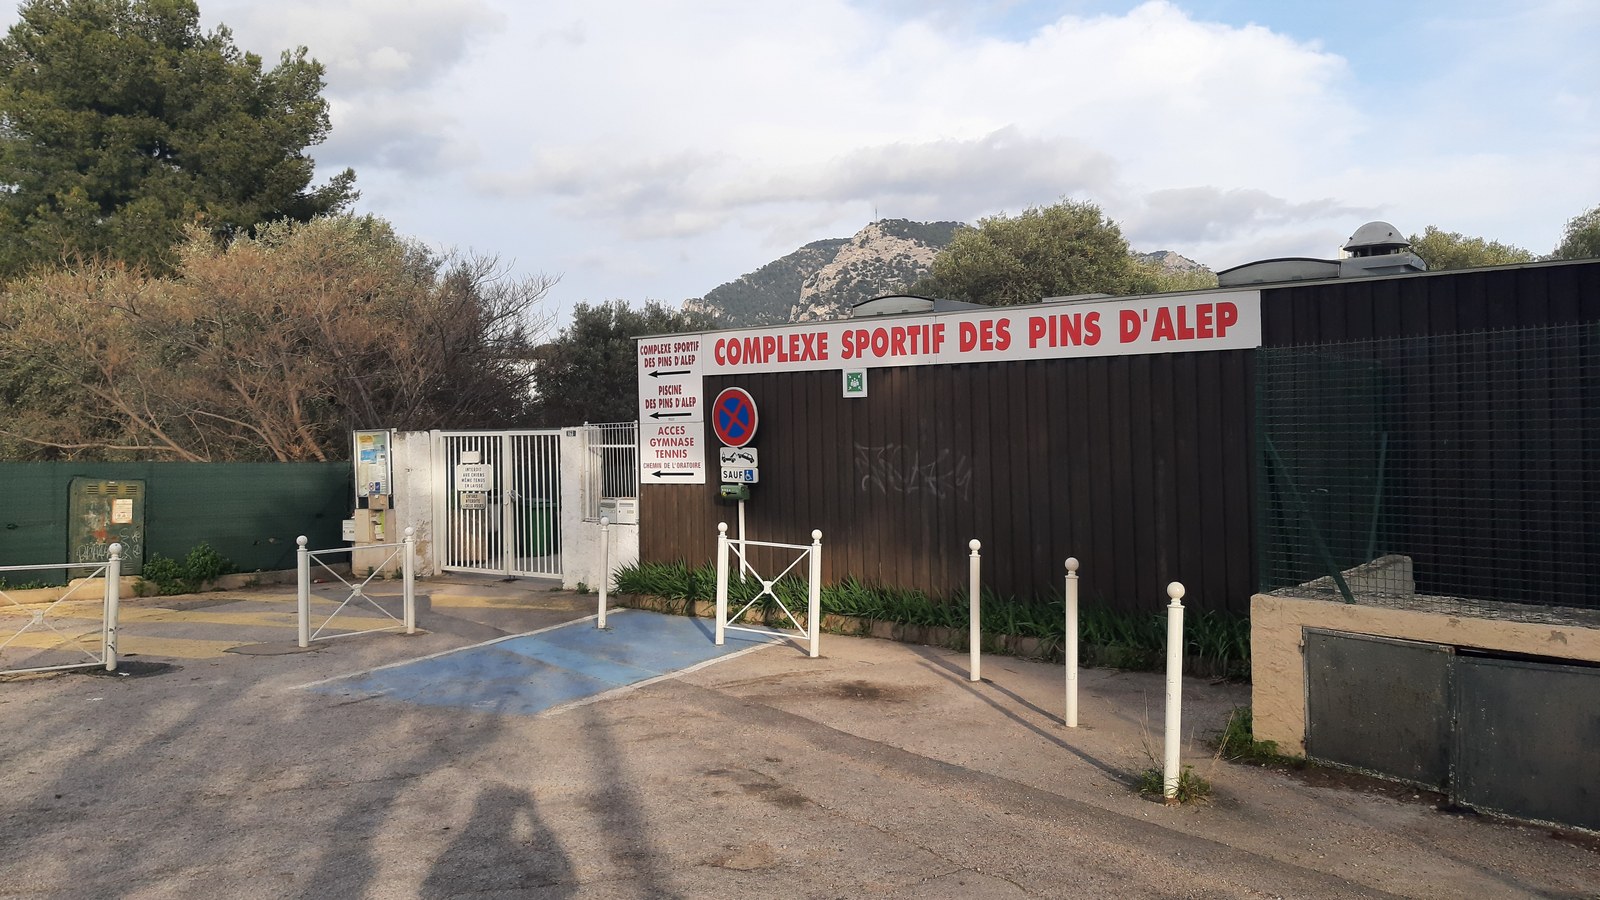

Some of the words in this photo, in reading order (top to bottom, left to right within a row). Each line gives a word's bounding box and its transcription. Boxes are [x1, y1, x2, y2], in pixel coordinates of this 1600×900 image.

[714, 332, 828, 366] COMPLEXE
[841, 323, 945, 360] SPORTIF
[959, 317, 1011, 353] DES
[1029, 311, 1101, 348] PINS
[1119, 301, 1239, 343] D'ALEP
[639, 343, 671, 356] COMPLEXE
[674, 340, 699, 353] SPORTIF
[644, 357, 655, 368] DES
[657, 356, 672, 367] PINS
[675, 354, 696, 366] D'ALEP
[658, 384, 682, 396] PISCINE
[645, 398, 656, 409] DES
[658, 397, 673, 409] PINS
[675, 396, 697, 408] D'ALEP
[658, 426, 686, 435] ACCES
[649, 437, 695, 447] GYMNASE
[655, 449, 688, 459] TENNIS
[723, 470, 743, 479] SAUF
